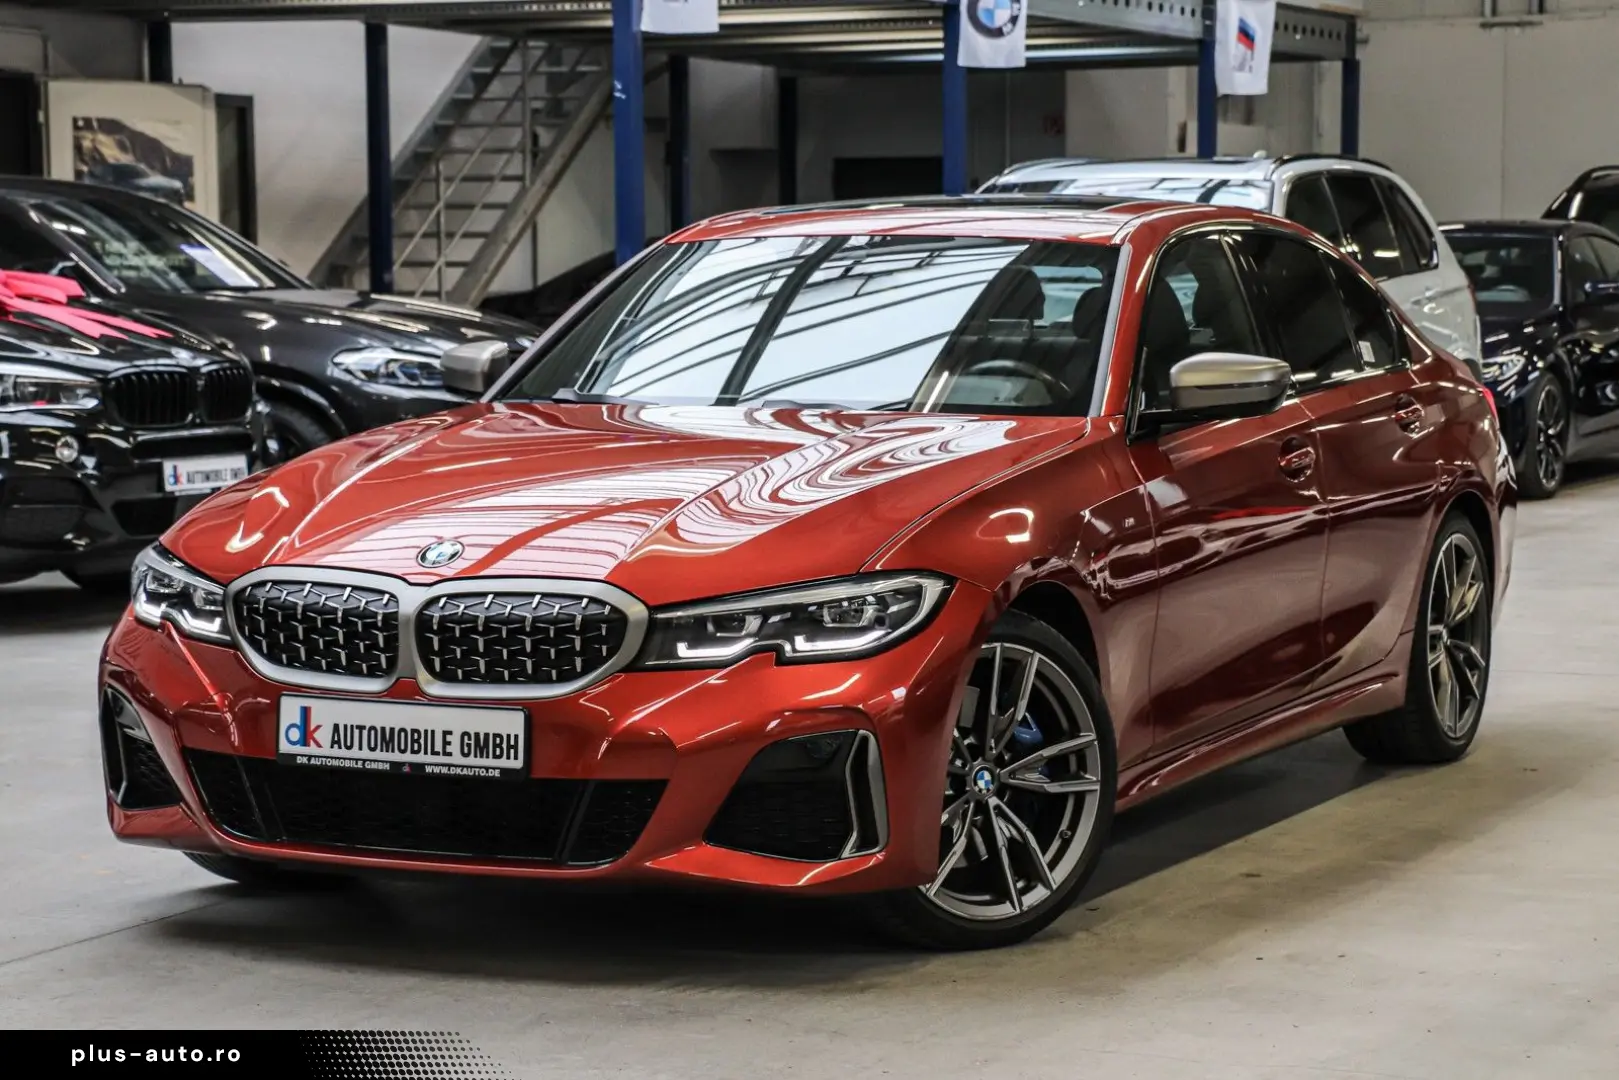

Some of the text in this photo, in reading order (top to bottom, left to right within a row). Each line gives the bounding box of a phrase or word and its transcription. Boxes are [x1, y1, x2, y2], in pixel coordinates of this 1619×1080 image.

[284, 705, 519, 760] dk AUTOMOBILE GMBH
[296, 756, 309, 764] DK
[310, 757, 363, 768] AUTOMOBILE
[364, 760, 390, 770] GMBH
[425, 765, 501, 777] WWW.DKAUTO.DE
